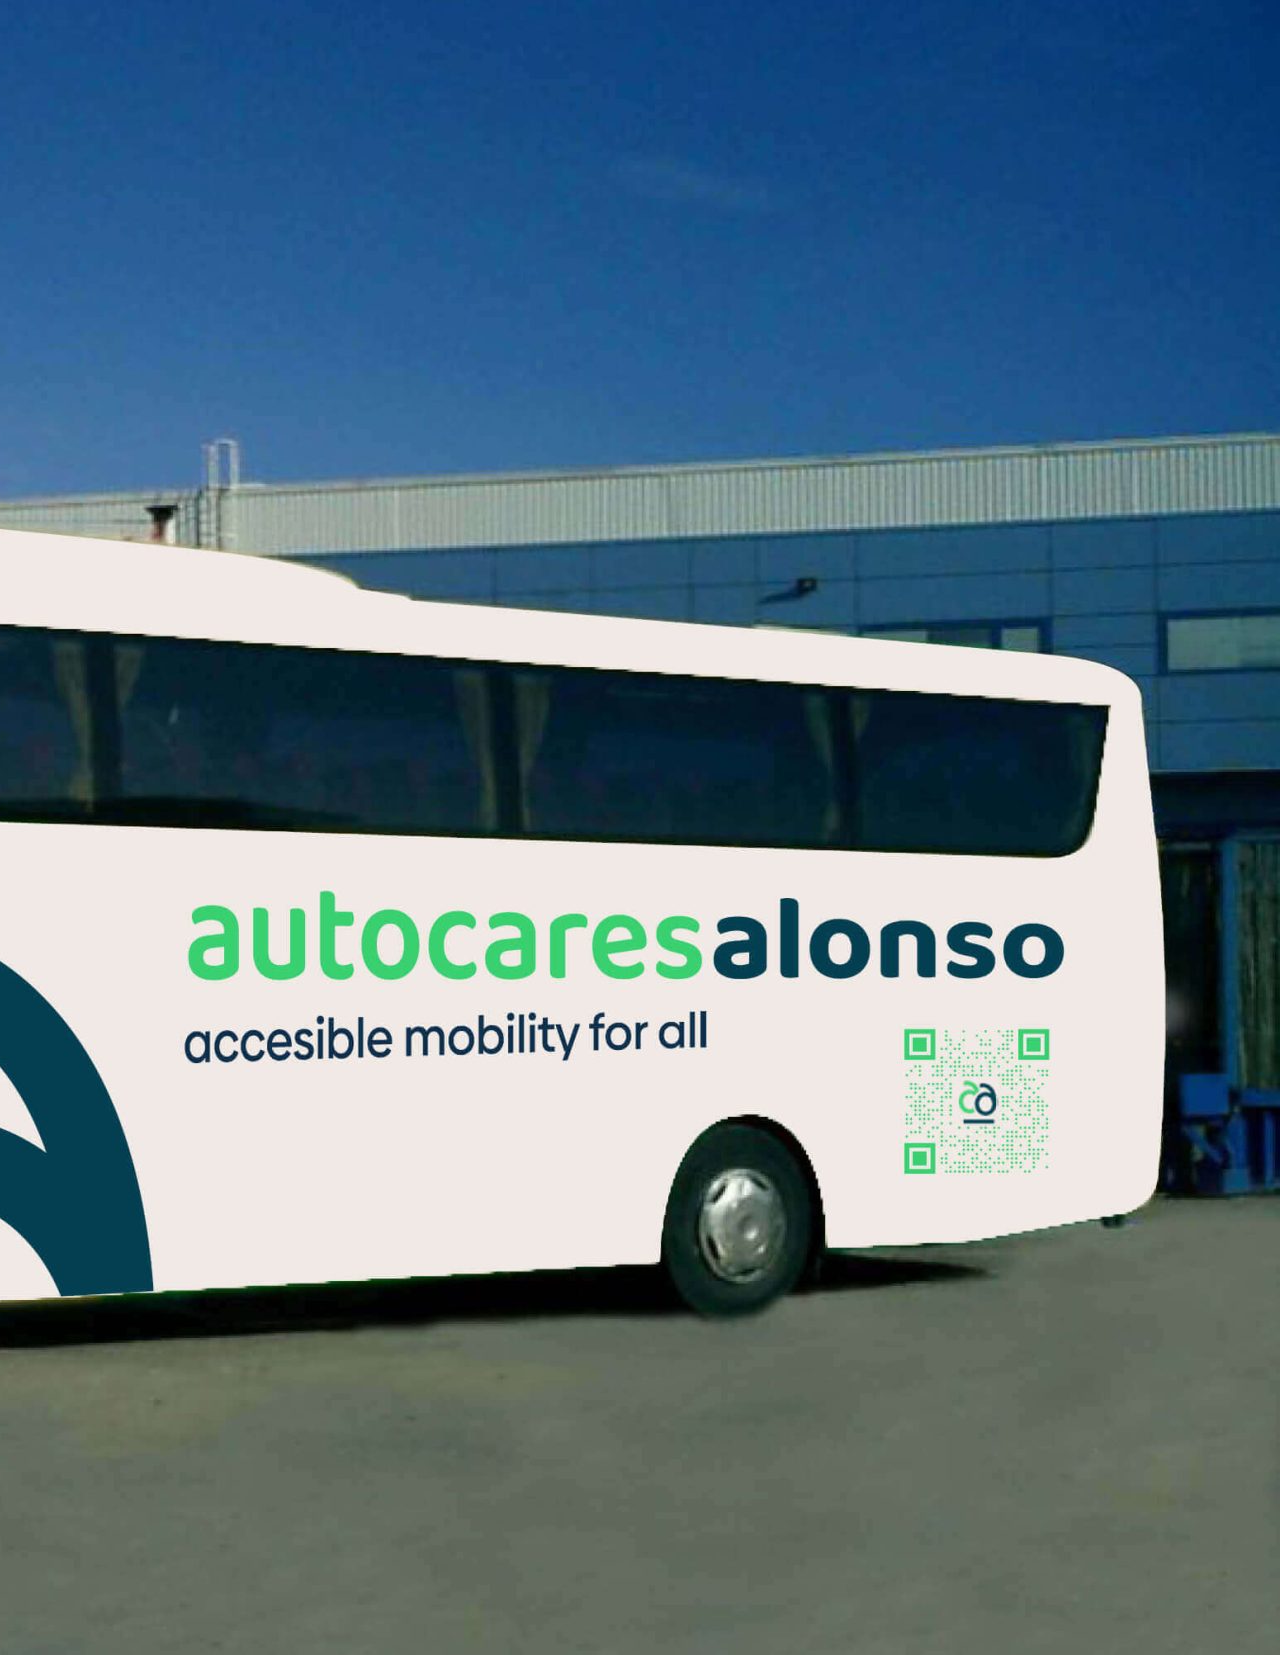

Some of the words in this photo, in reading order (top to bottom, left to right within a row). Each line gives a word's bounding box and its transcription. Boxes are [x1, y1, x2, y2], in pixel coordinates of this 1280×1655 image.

[184, 1015, 393, 1064] accesible
[405, 1012, 580, 1061] mobility
[589, 1012, 650, 1051] for
[658, 1010, 708, 1049] all
